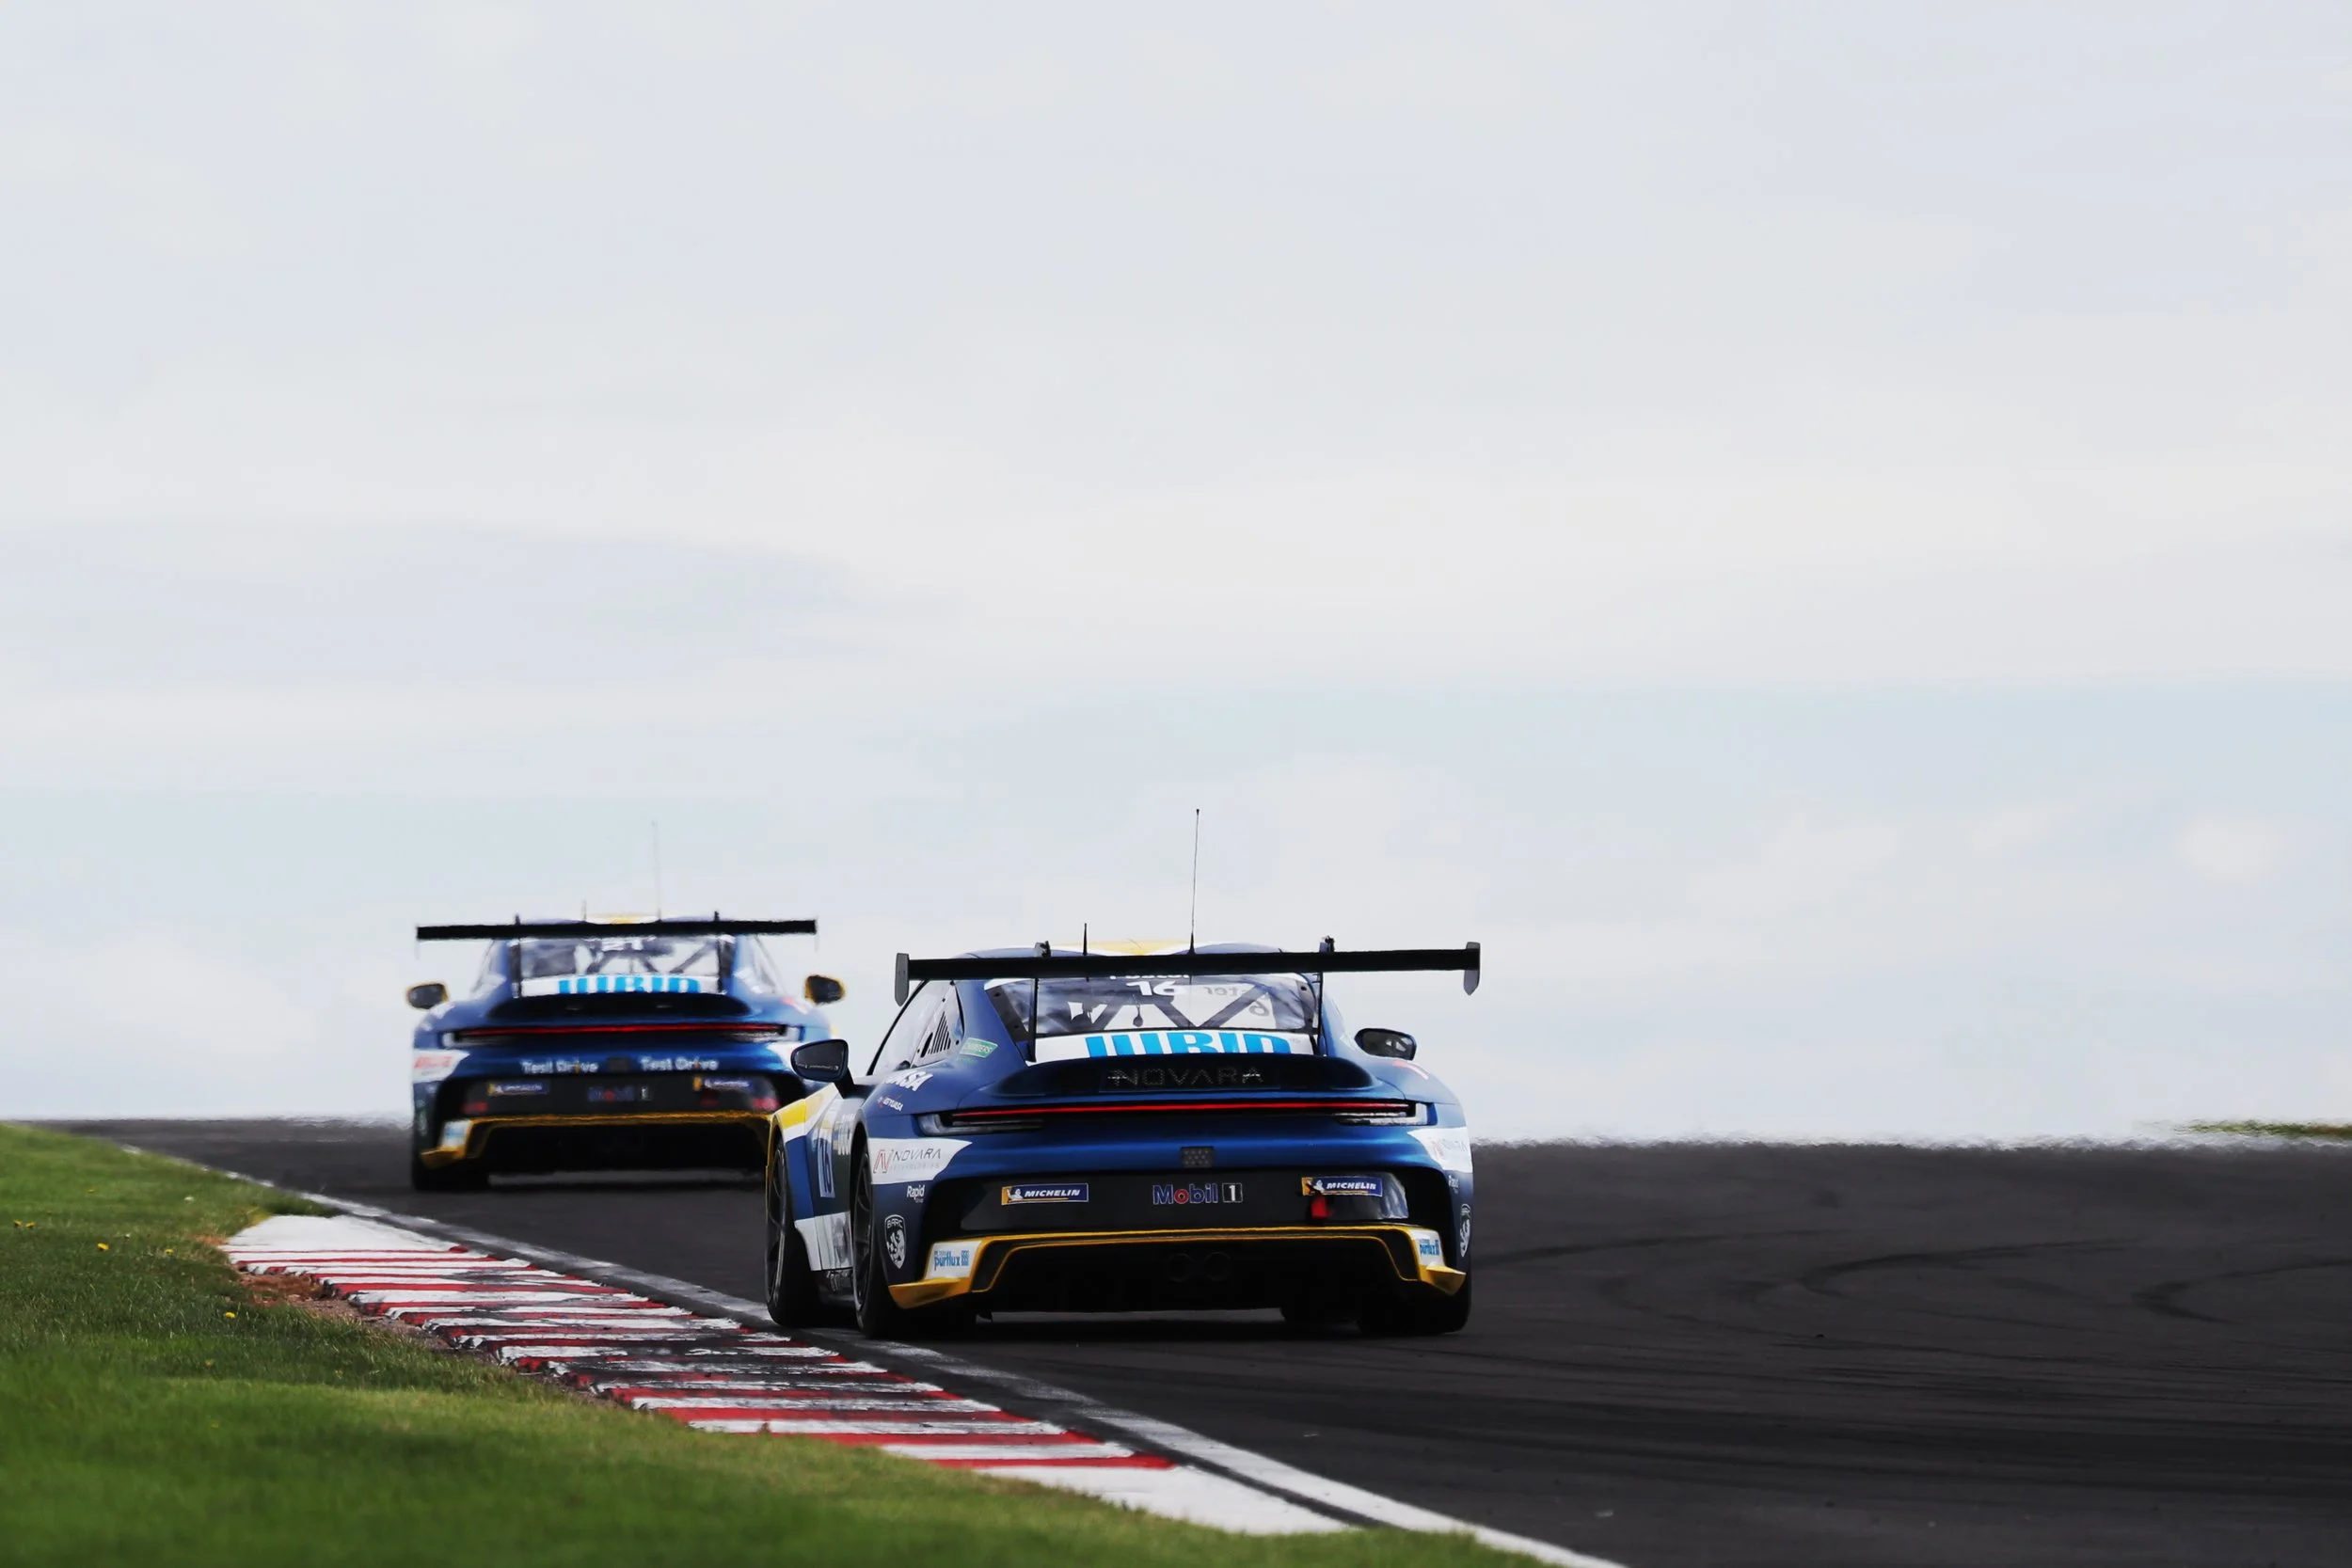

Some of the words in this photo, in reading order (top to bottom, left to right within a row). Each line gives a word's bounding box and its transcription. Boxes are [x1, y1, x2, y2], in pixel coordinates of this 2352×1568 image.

[1125, 980, 1187, 996] 16
[892, 1148, 942, 1163] NOVARA
[907, 1185, 925, 1200] Rapid
[1024, 1189, 1081, 1197] MICHELIN
[1327, 1181, 1377, 1190] MICHELIN
[1152, 1183, 1218, 1205] Mobil
